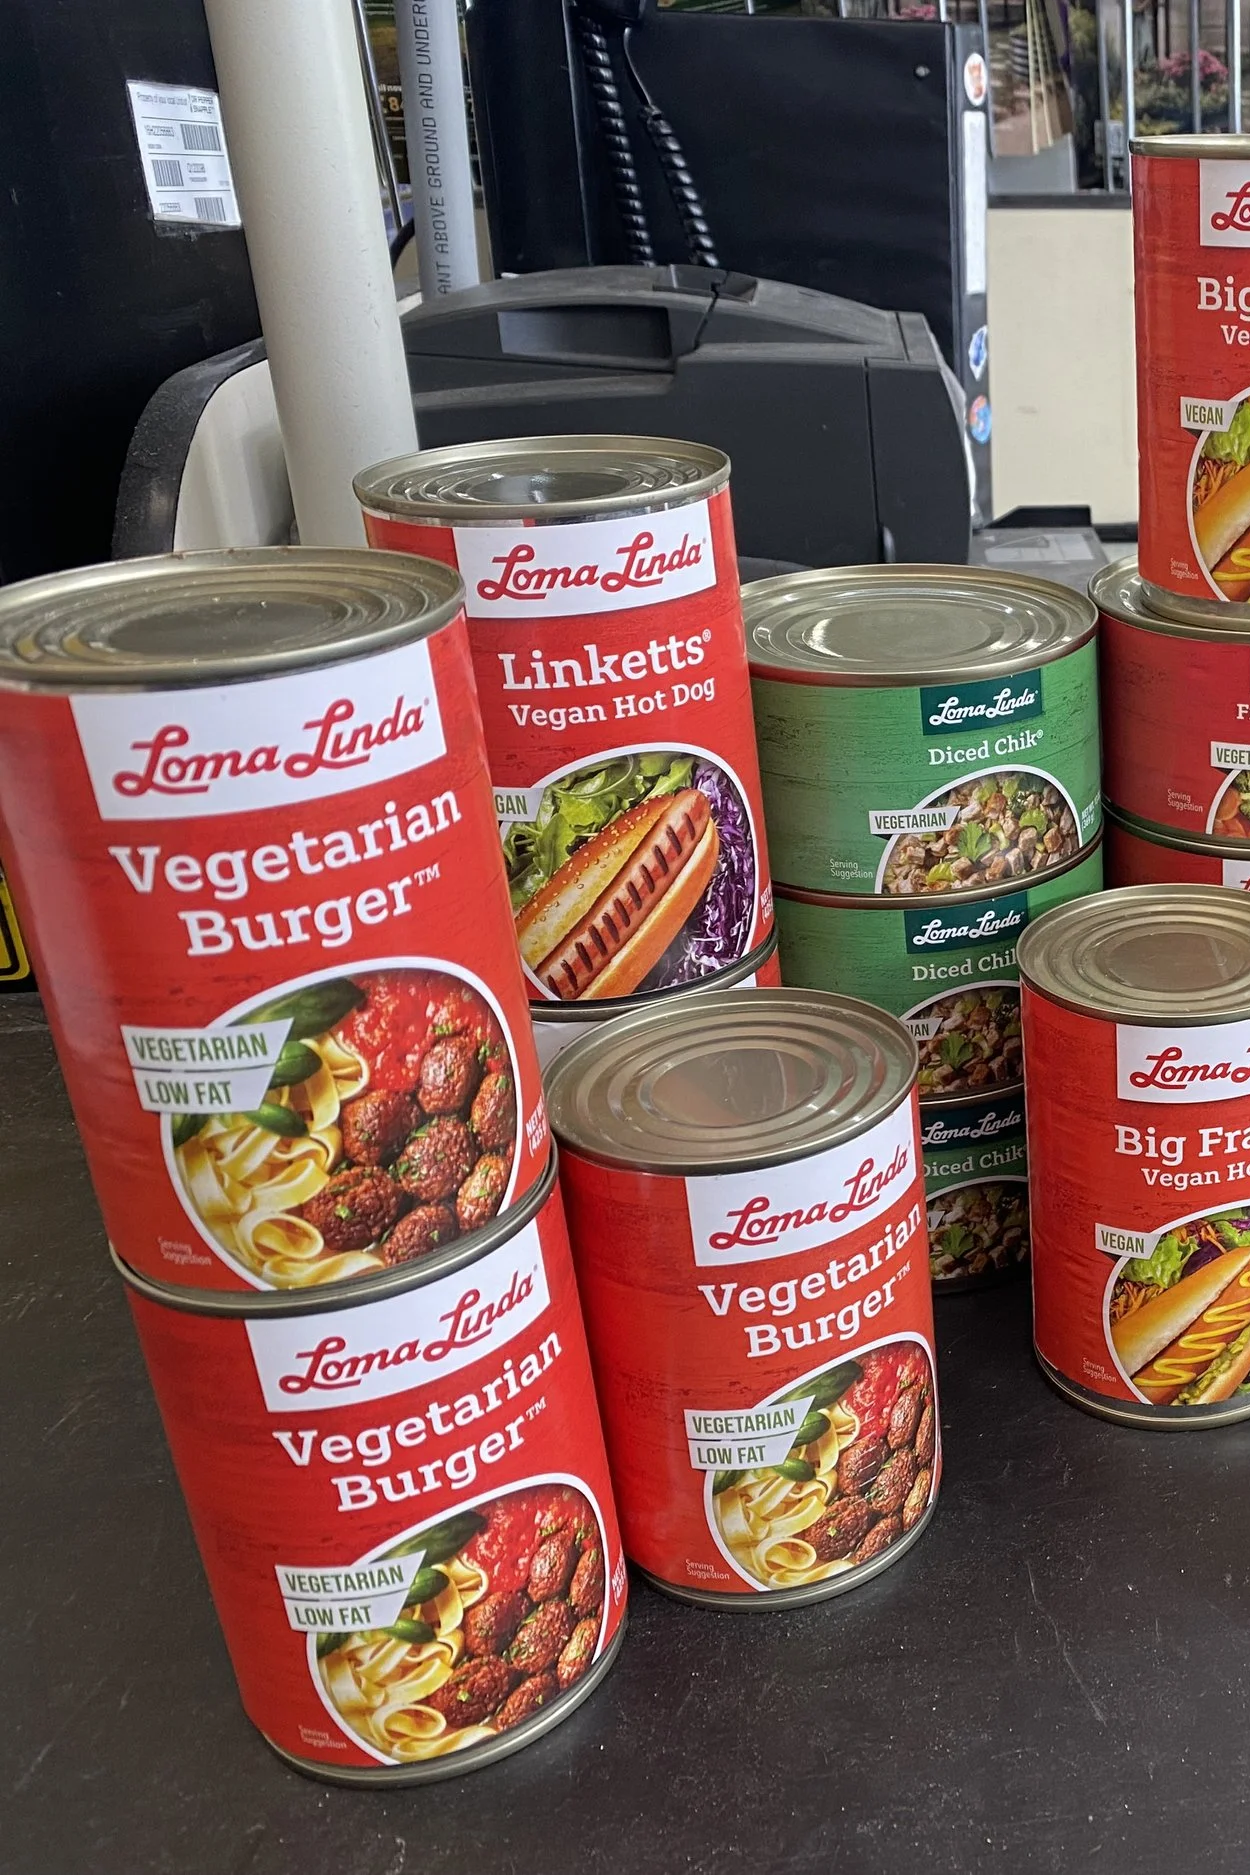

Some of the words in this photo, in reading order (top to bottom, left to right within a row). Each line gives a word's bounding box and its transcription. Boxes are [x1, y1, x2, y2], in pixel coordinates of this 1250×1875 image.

[418, 73, 435, 109] AND
[422, 117, 443, 188] GROUND
[429, 197, 449, 254] ABOVE
[1185, 404, 1223, 425] VEGAN
[476, 544, 599, 600] Loma
[600, 531, 702, 593] Linda
[508, 703, 606, 731] Vegan
[613, 690, 667, 719] Hot
[672, 677, 715, 708] Dog
[929, 696, 985, 726] Loma
[985, 688, 1035, 719] Linda
[112, 724, 280, 798] Loma
[283, 696, 424, 779] Linda
[928, 741, 989, 765] Diced
[495, 793, 528, 815] GAN
[1167, 789, 1191, 803] Serving
[1167, 797, 1203, 812] Suggestion
[875, 813, 947, 829] VEGETARIAN
[108, 789, 462, 900] Vegetarian
[912, 919, 968, 945] Loma
[968, 910, 1022, 937] Linda
[912, 957, 972, 982] Diced
[132, 1033, 268, 1061] VEGETARIAN
[1129, 1047, 1232, 1090] Loma
[146, 1082, 195, 1106] LOW
[198, 1080, 233, 1105] FAT
[921, 1121, 970, 1145] Loma
[970, 1111, 1021, 1138] Linda
[1114, 1124, 1186, 1166] Big
[1141, 1168, 1220, 1191] Vegan
[709, 1196, 828, 1250] Loma
[829, 1144, 908, 1223] Linda
[1101, 1230, 1145, 1254] VEGAN
[698, 1203, 921, 1316] Vegetarian
[279, 1337, 421, 1394] Loma
[422, 1270, 534, 1361] Linda
[272, 1331, 562, 1466] Vegetarian
[692, 1408, 795, 1434] VEGETARIAN
[697, 1447, 733, 1464] LOW
[737, 1445, 766, 1464] FAT
[284, 1565, 404, 1594] VEGETARIAN
[686, 1559, 715, 1572] Serving
[687, 1568, 730, 1580] Suggestion
[295, 1607, 337, 1627] LOW
[339, 1604, 371, 1625] FAT
